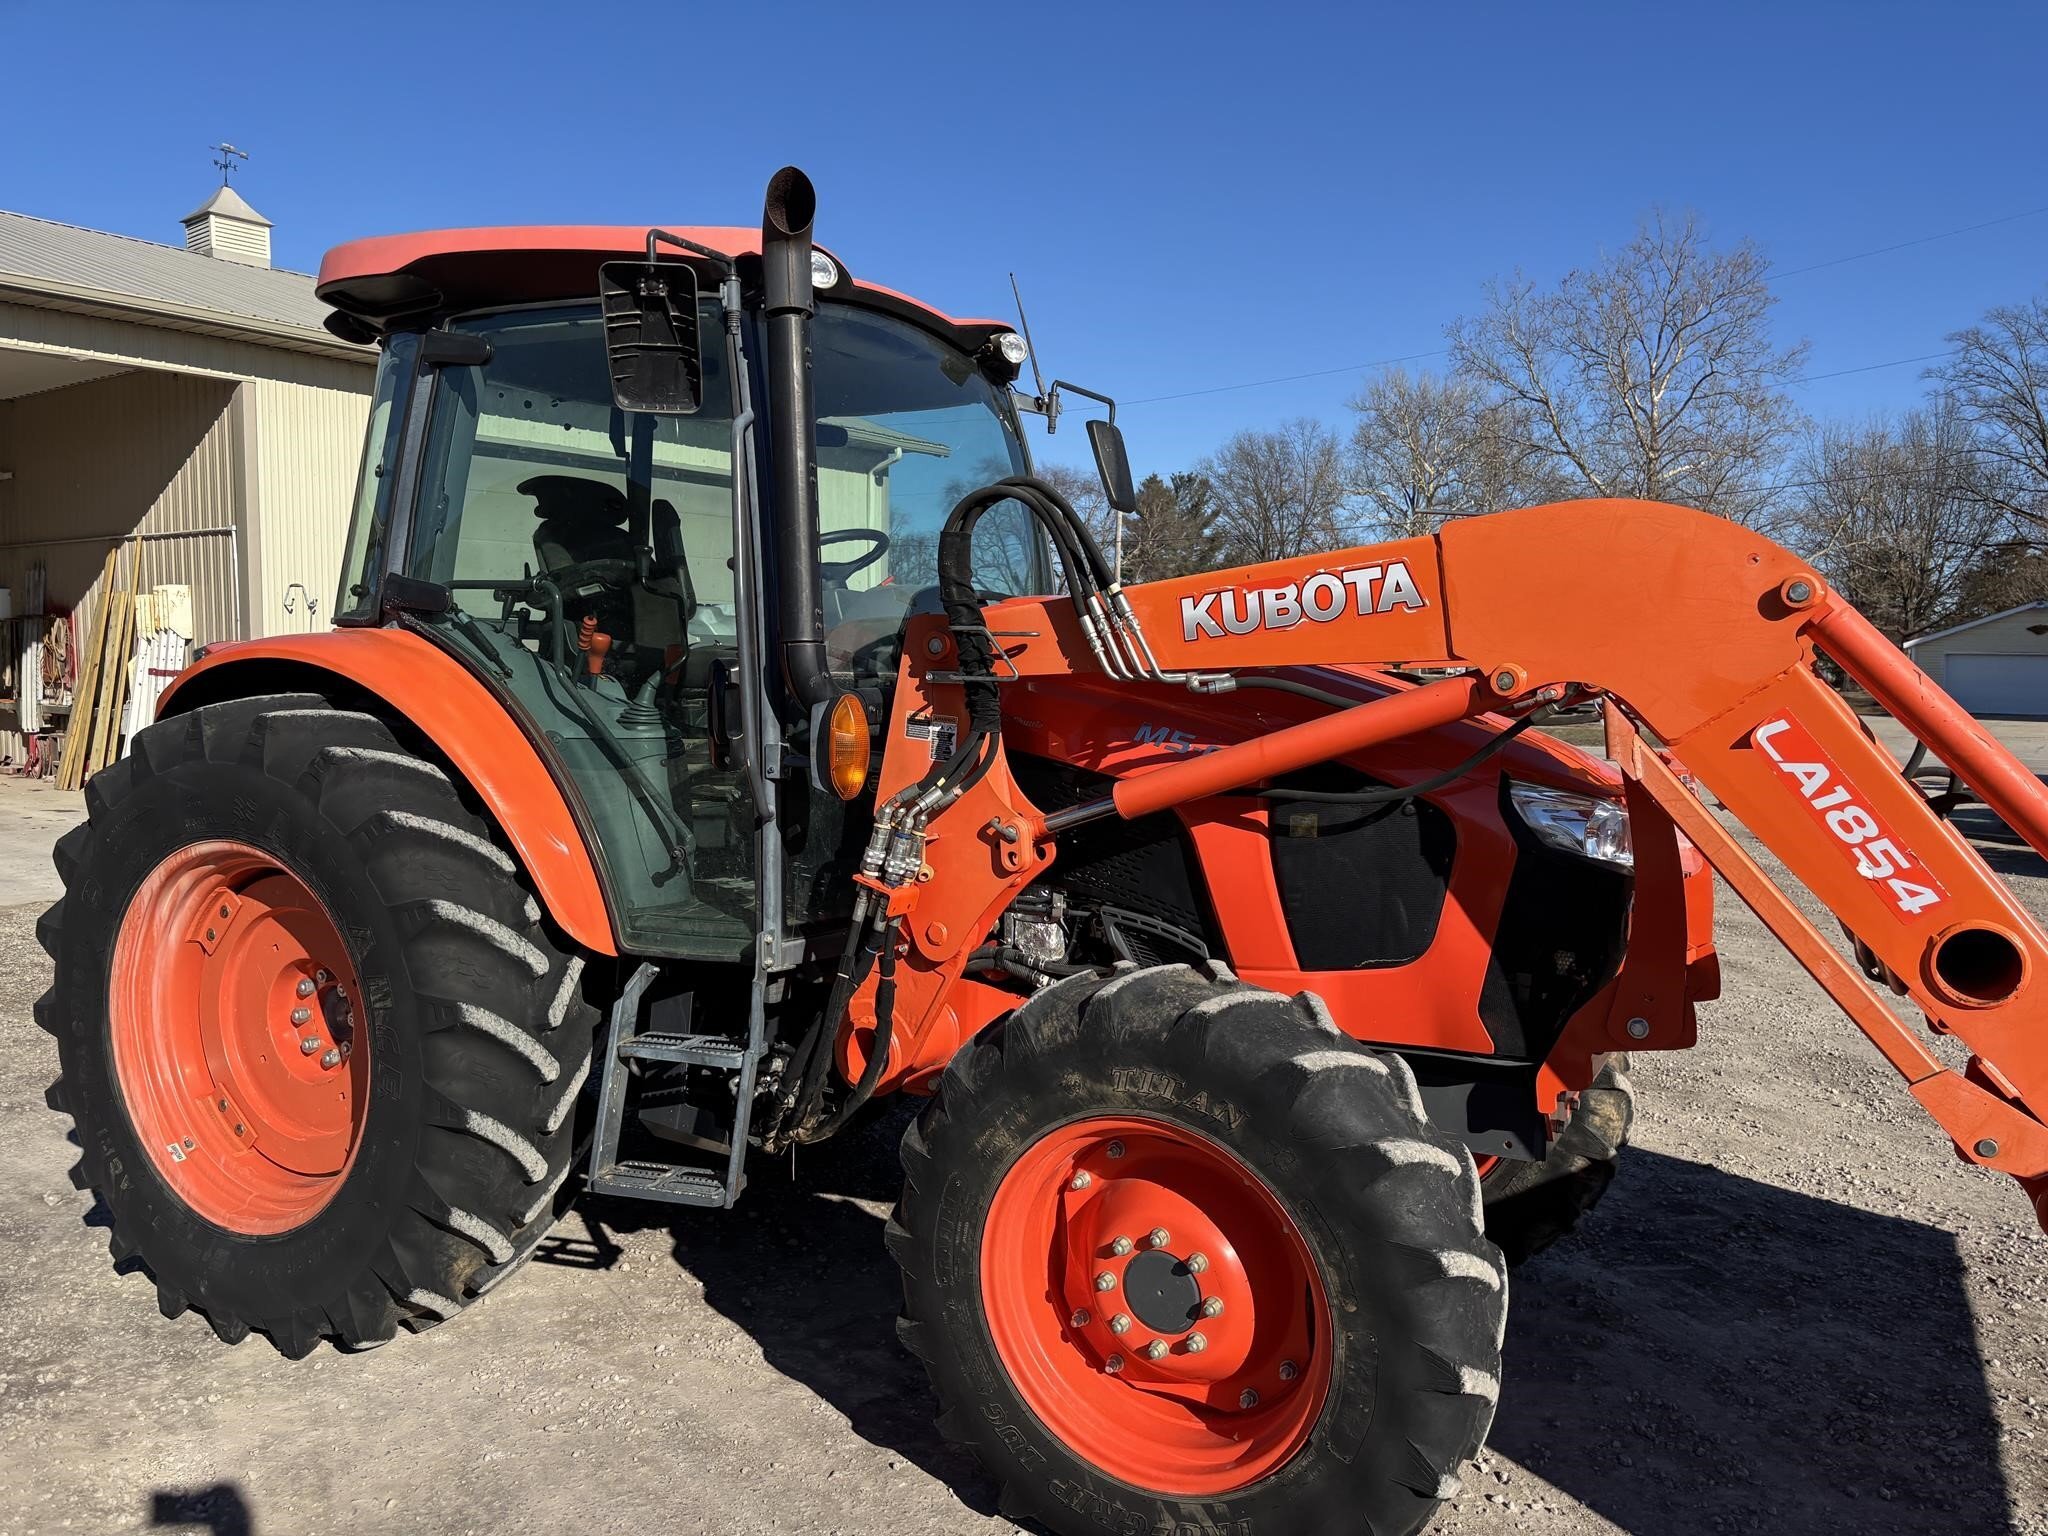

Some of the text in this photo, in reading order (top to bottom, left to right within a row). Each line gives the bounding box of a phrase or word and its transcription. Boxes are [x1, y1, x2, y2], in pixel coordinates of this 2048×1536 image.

[1179, 561, 1425, 642] KUBOTA
[1133, 722, 1224, 756] M5-
[1755, 719, 1942, 915] LA1854
[1111, 1066, 1251, 1130] TITAN
[979, 1402, 1048, 1473] LUG
